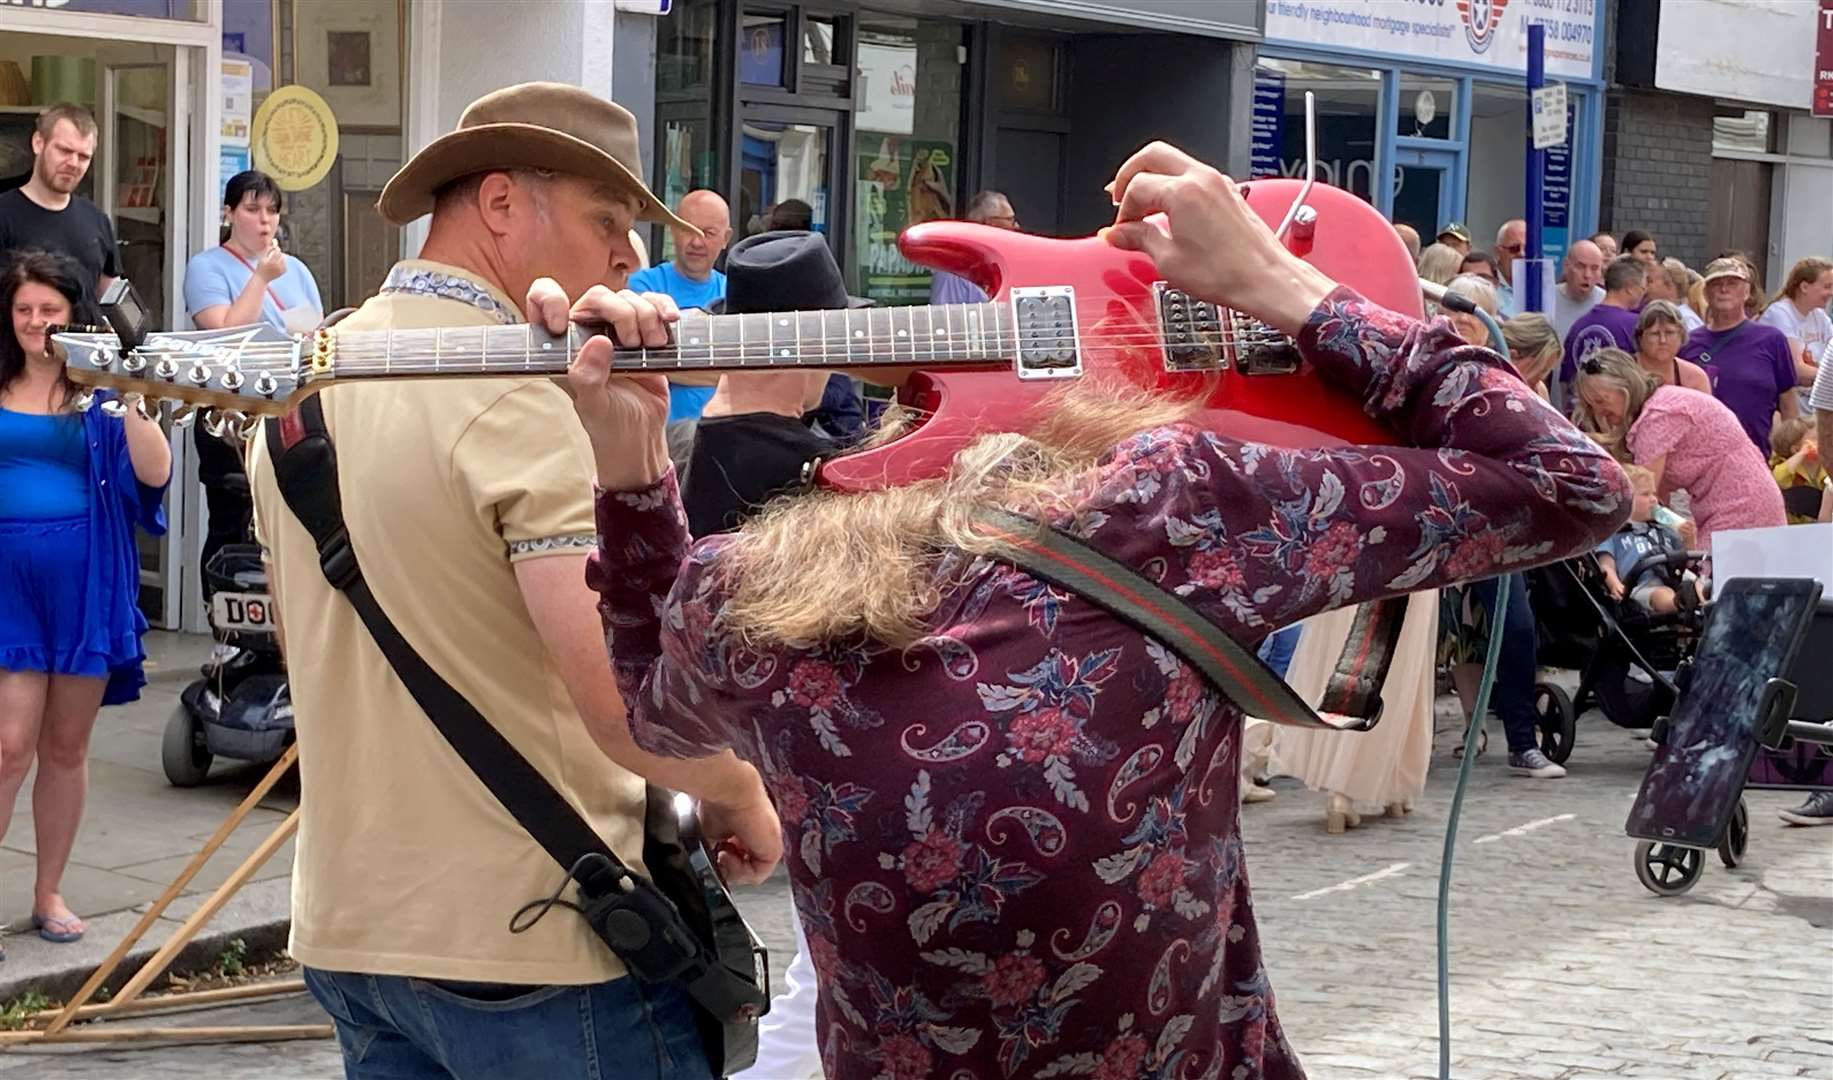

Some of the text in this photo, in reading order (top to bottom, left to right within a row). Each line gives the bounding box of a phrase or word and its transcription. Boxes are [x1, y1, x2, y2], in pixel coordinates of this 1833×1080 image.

[1278, 2, 1309, 22] friendly
[1310, 7, 1373, 28] neighbourhood
[1373, 16, 1410, 35] mortgage
